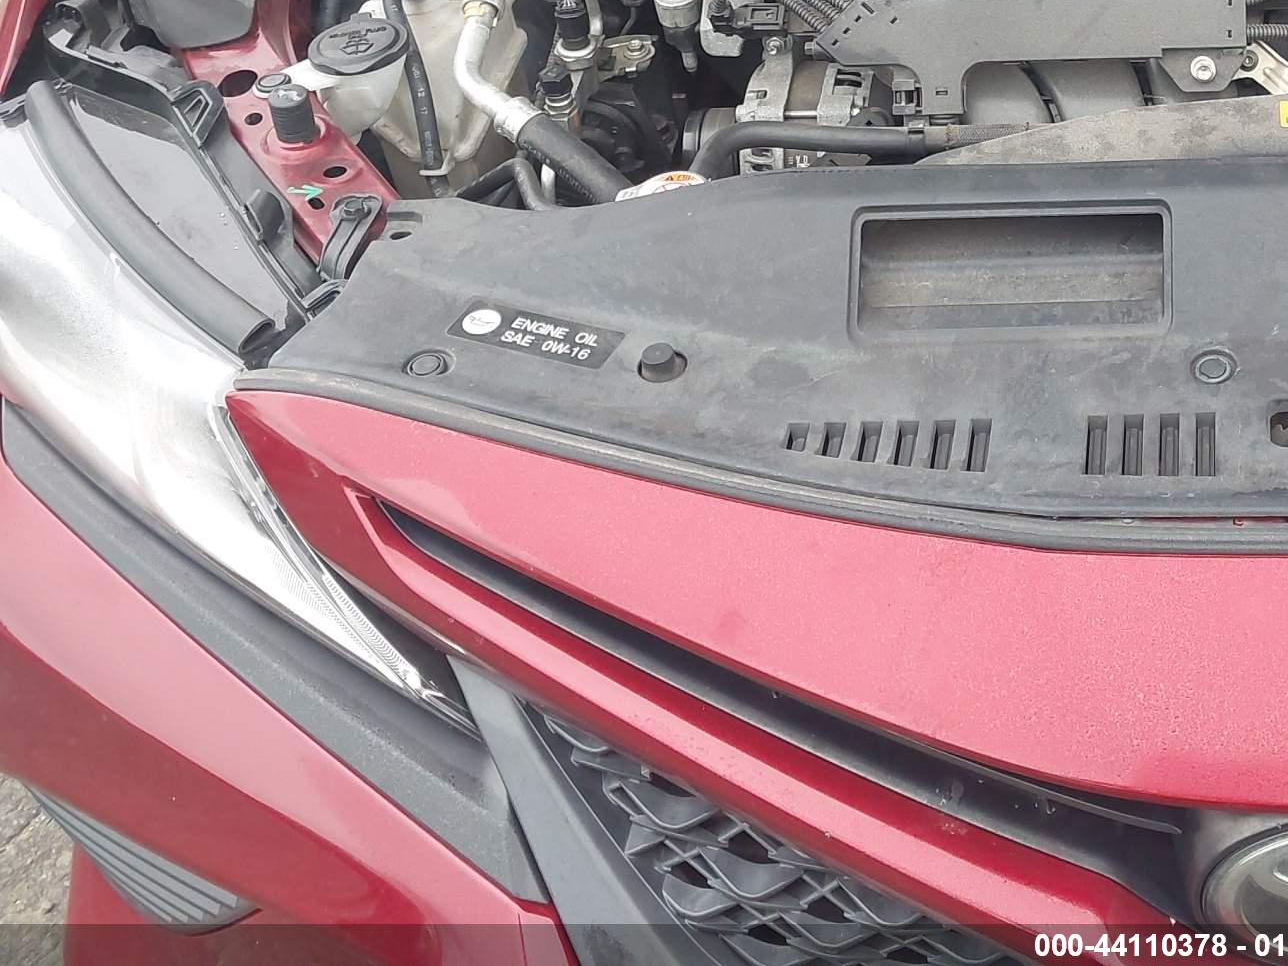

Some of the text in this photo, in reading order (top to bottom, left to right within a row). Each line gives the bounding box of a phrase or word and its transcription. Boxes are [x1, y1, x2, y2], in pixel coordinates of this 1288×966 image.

[500, 330, 592, 360] SAE 0W-16
[511, 316, 599, 348] ENGINE OIL
